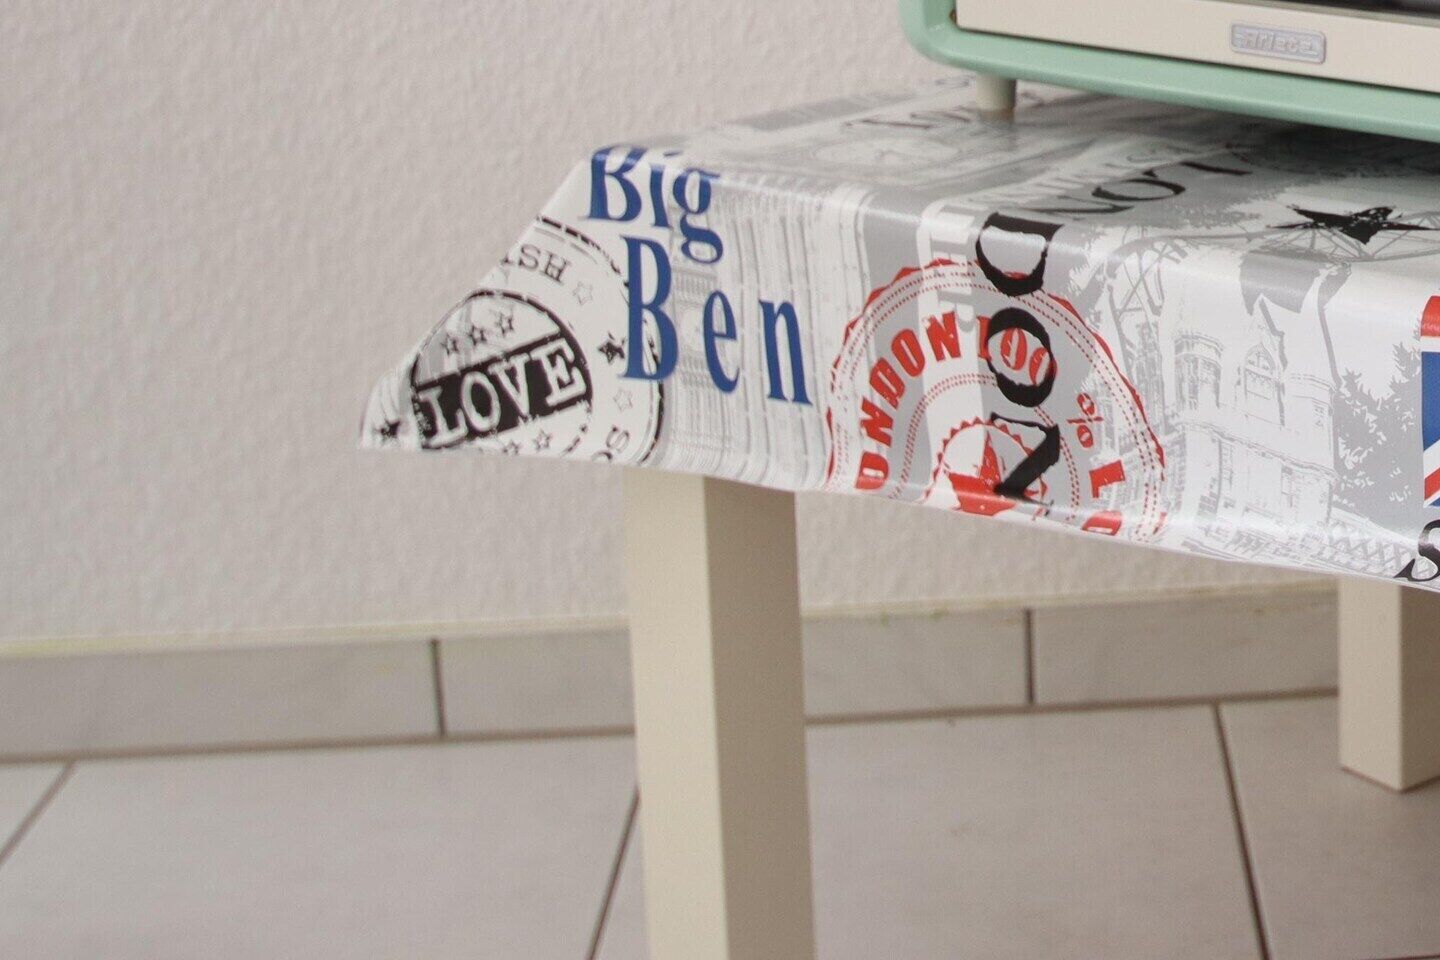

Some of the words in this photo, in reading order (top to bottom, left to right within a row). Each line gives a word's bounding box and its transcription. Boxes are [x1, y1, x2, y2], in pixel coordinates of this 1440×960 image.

[583, 145, 725, 264] Big
[419, 338, 588, 443] LOVE
[617, 233, 814, 406] Ben
[855, 311, 962, 491] ONDON
